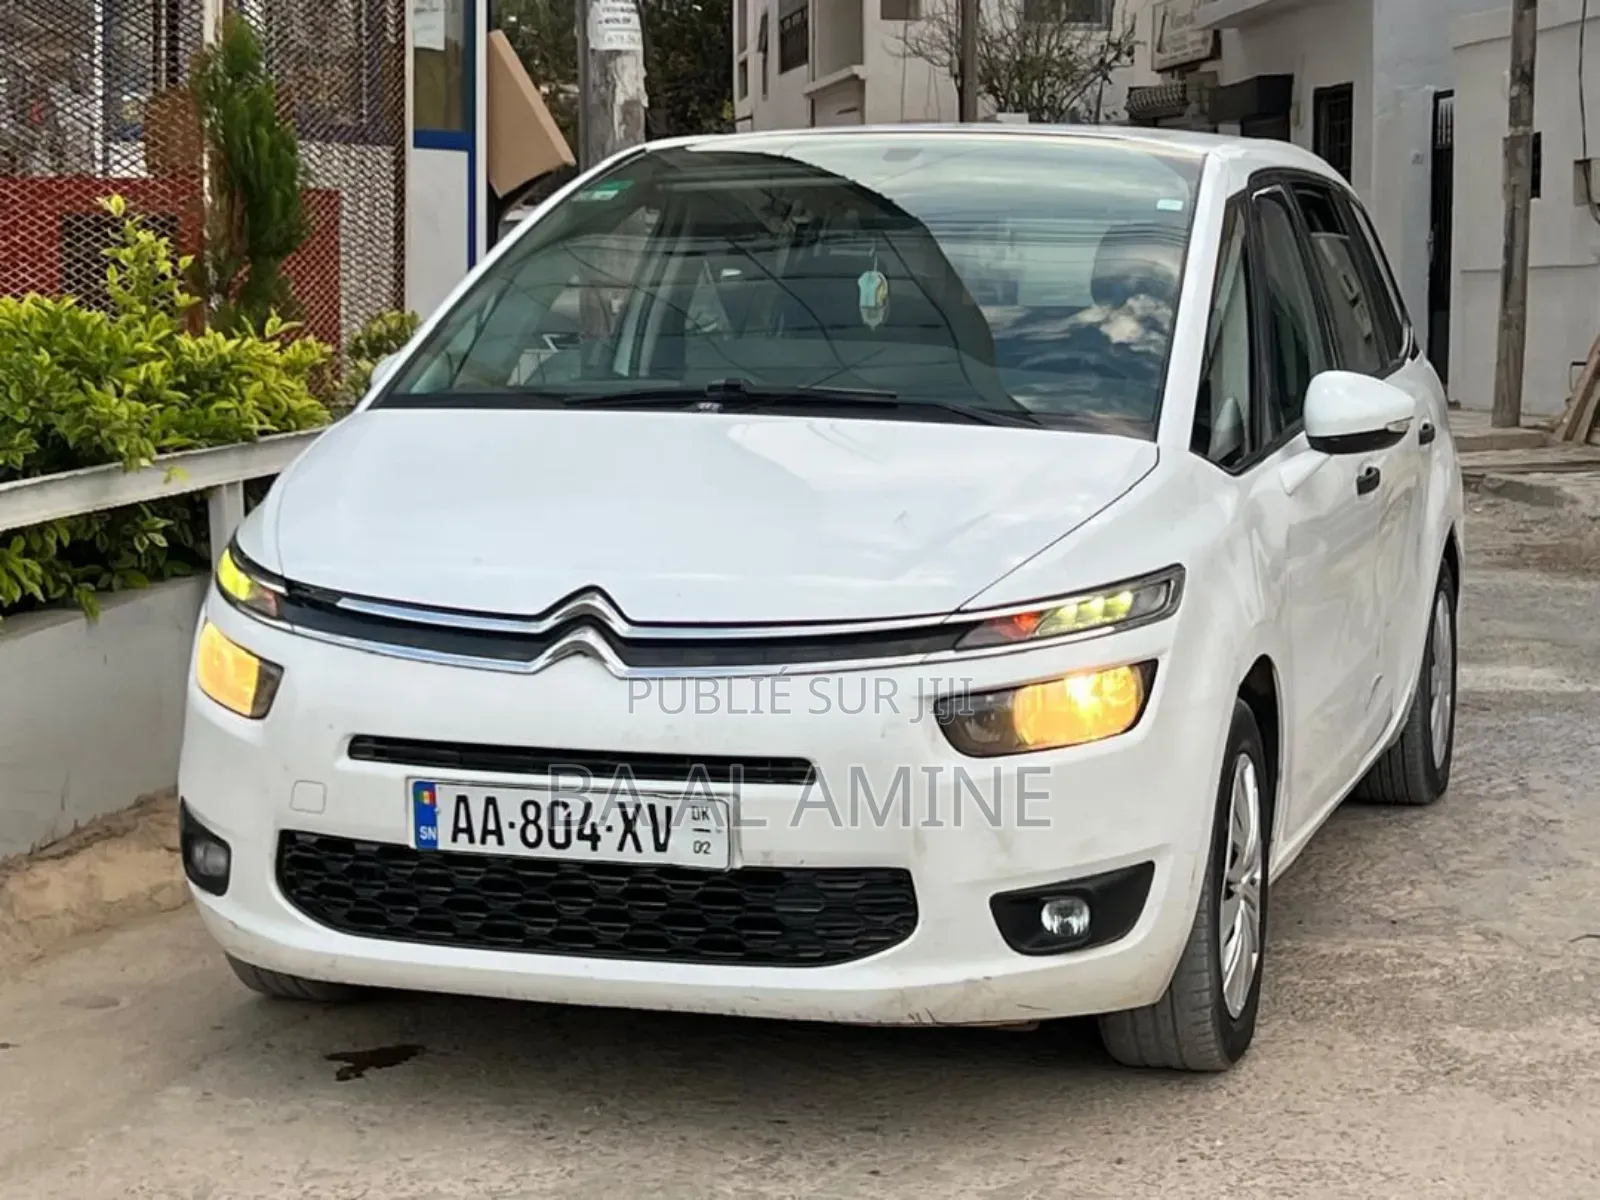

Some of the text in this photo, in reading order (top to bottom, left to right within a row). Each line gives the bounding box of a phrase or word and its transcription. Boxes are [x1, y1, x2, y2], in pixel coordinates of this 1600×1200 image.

[691, 805, 711, 822] DK
[419, 825, 437, 841] SN
[692, 839, 712, 855] 02
